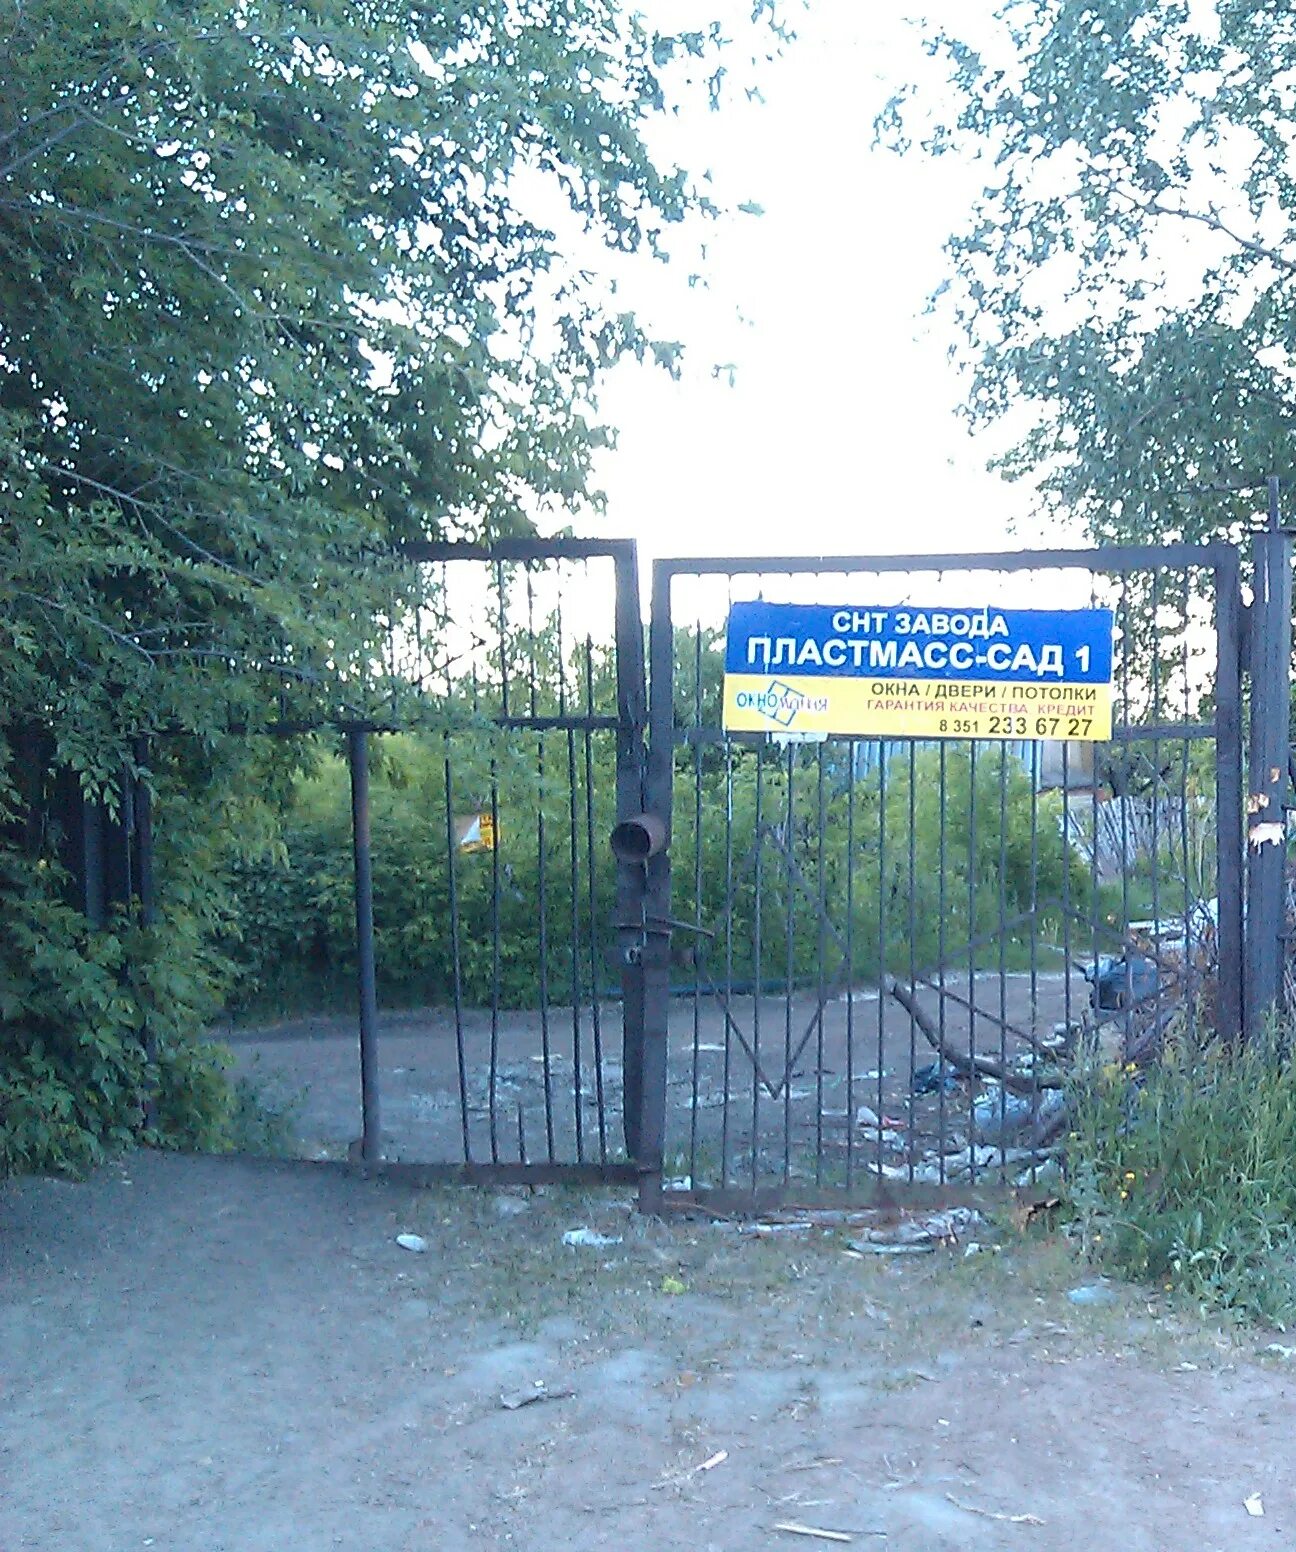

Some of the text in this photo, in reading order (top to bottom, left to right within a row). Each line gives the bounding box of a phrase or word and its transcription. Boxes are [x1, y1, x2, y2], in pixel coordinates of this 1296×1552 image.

[832, 611, 1009, 639] СНТ ЗАВОДА
[747, 637, 1091, 676] ПЛАСТМАСС-САД 1
[871, 682, 919, 696] ОКНА
[935, 684, 996, 699] ДВЕРИ
[1012, 686, 1097, 700] ПОТОЛКИ
[867, 699, 1095, 716] ГАРАНТИЯ КАЧЕСТВА КРЕДИТ
[939, 716, 1093, 737] 8 351 233 67 27
